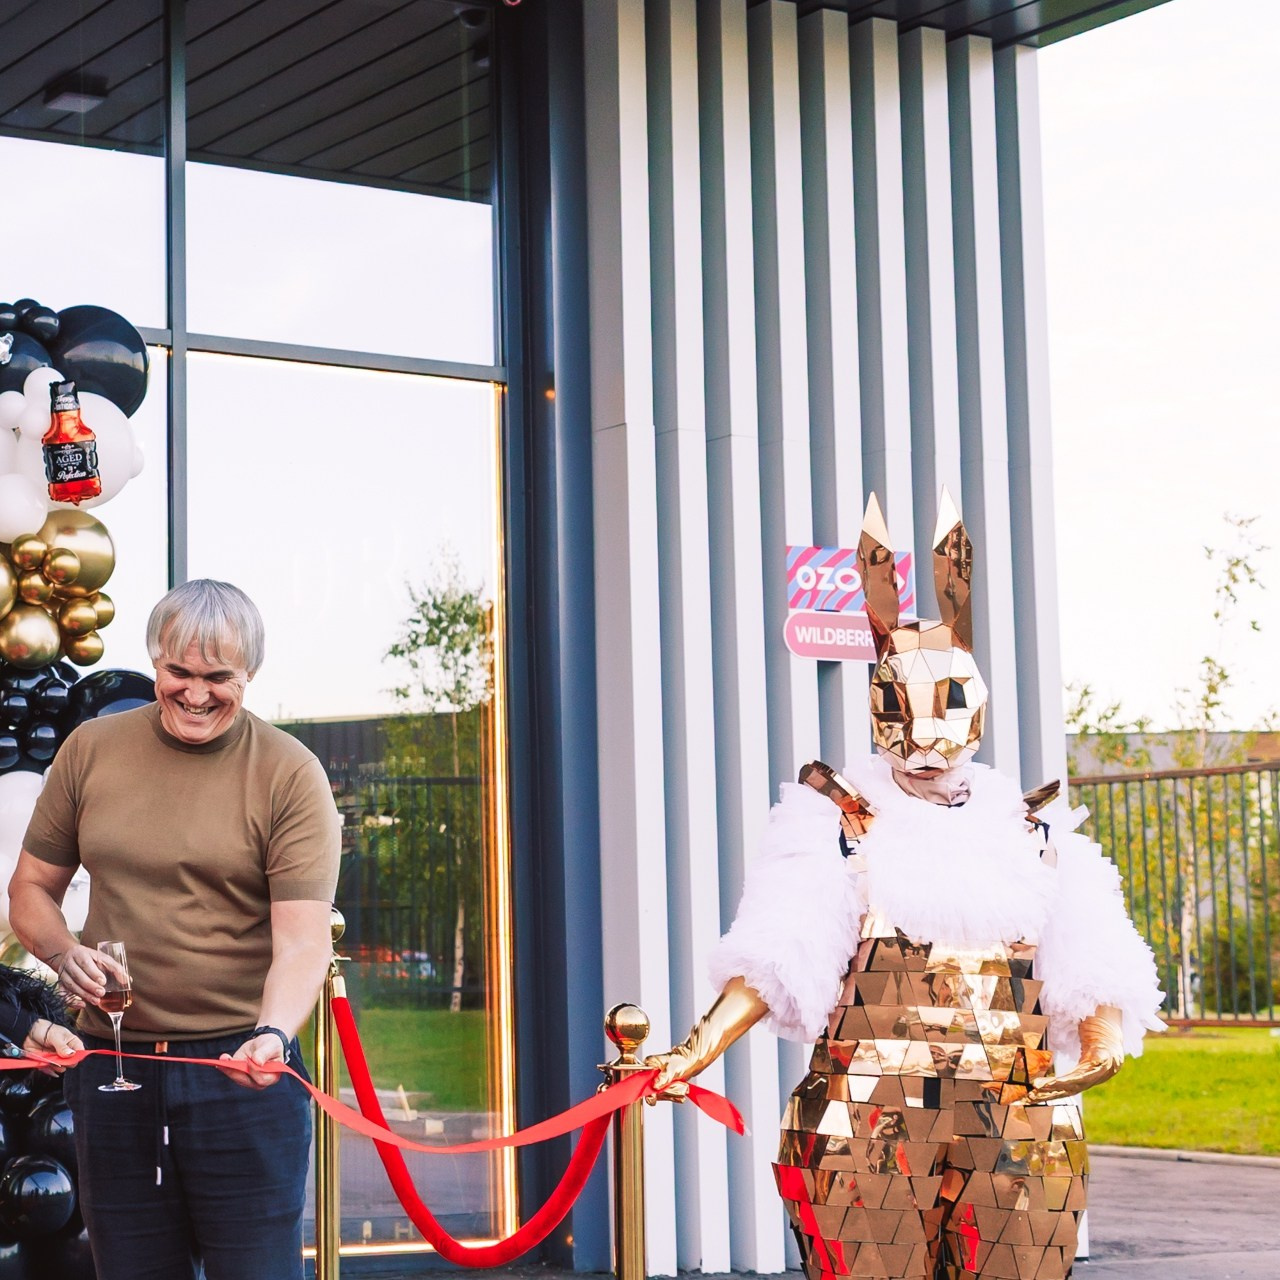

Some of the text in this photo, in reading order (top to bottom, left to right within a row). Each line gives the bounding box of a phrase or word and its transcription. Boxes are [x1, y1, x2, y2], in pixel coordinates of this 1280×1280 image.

[56, 453, 83, 464] AGED
[796, 565, 862, 593] OZO
[794, 625, 875, 648] WILDBERR
